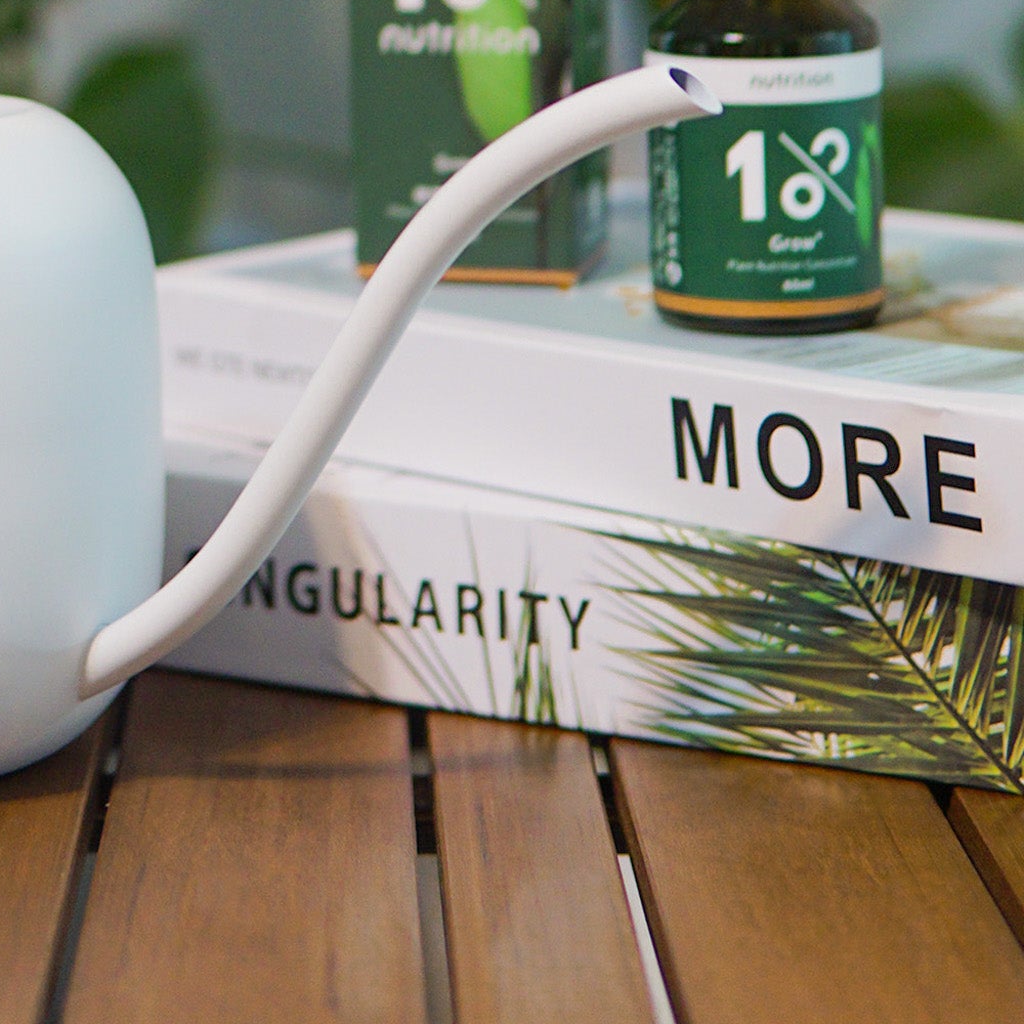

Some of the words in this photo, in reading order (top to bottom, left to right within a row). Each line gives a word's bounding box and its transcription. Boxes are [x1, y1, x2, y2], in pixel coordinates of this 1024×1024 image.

[379, 21, 541, 54] nutrition
[749, 72, 834, 90] nutrition
[671, 396, 983, 533] MORE
[185, 548, 591, 651] NGULARITY
